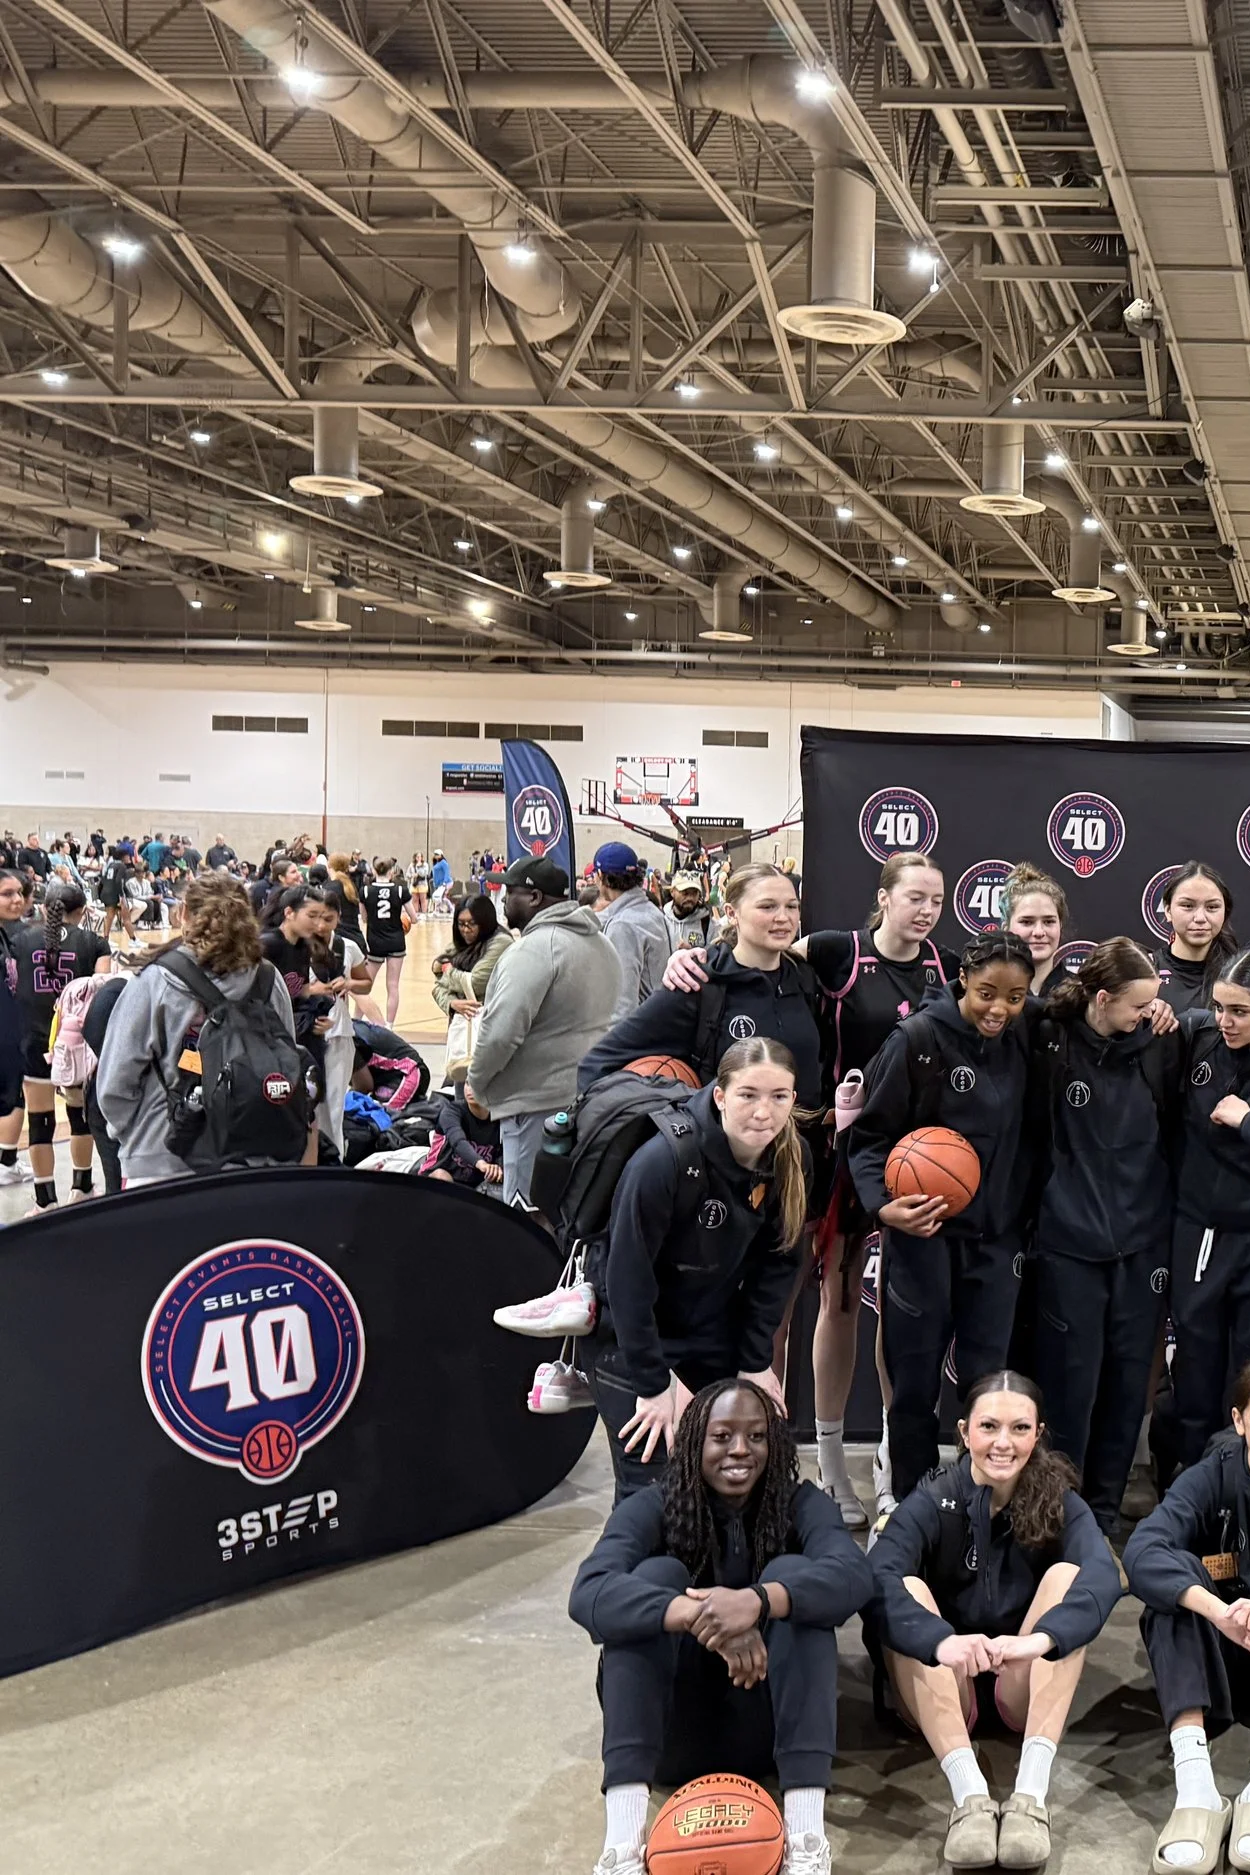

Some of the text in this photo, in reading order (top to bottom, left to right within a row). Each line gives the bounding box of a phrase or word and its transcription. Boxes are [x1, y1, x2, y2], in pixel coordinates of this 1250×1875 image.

[520, 805, 552, 836] 40
[881, 803, 916, 812] SELECT
[1069, 808, 1104, 816] SELECT
[873, 811, 919, 846] 40
[1061, 817, 1106, 851] 40
[977, 876, 1006, 884] SELEC
[377, 899, 391, 919] 2
[32, 949, 76, 993] 25
[155, 1298, 181, 1373] SELECT
[188, 1251, 255, 1289] EVENTS
[202, 1282, 295, 1312] SELECT
[189, 1304, 317, 1413] 40
[217, 1489, 338, 1548] 3STEP
[222, 1517, 339, 1562] SPORTS
[673, 1804, 754, 1827] LEGACY
